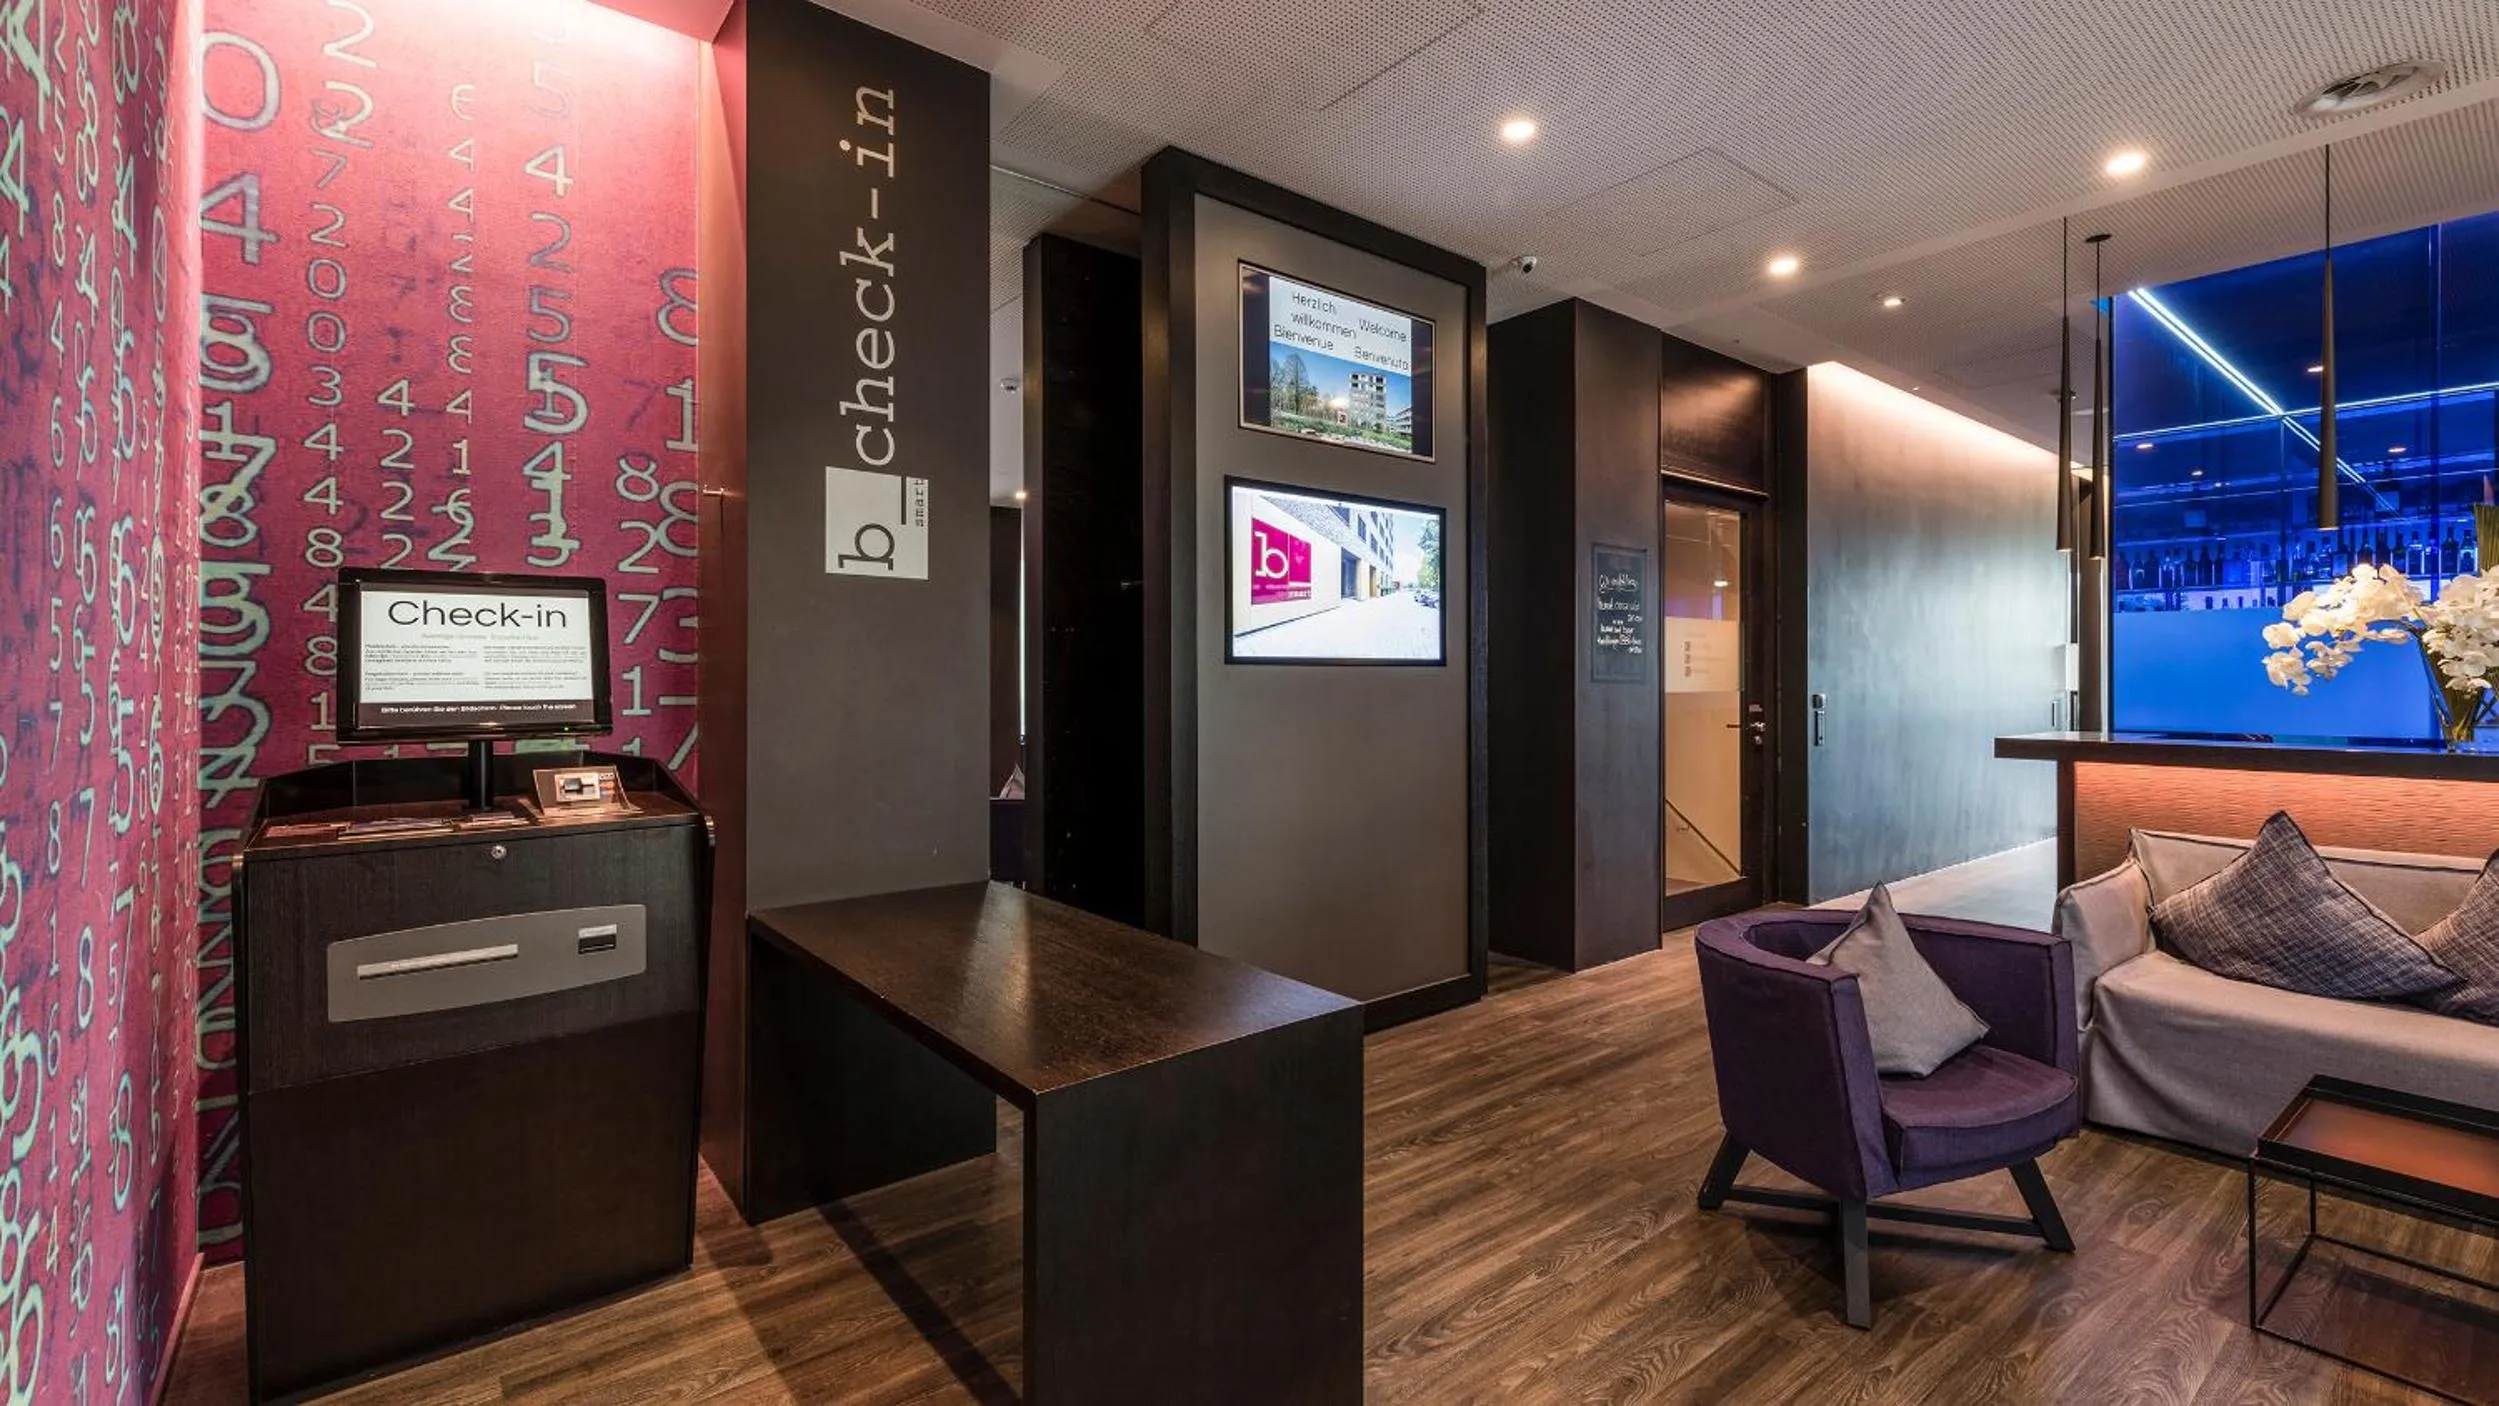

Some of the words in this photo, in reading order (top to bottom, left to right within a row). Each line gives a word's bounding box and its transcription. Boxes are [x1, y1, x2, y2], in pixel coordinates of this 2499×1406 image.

[521, 145, 575, 198] 4
[198, 171, 280, 265] 4
[309, 202, 349, 249] 2
[528, 211, 574, 274] 2
[307, 258, 348, 299] 0
[839, 87, 896, 467] check-in
[526, 285, 573, 343] 5
[1292, 291, 1336, 313] Herzlich
[307, 312, 347, 353] 0
[1273, 323, 1334, 351] Bienvenue
[1290, 312, 1357, 339] willkommen
[1358, 318, 1407, 342] Welcome
[1353, 345, 1409, 371] Benvenuto
[307, 365, 344, 407] 3
[376, 379, 416, 417] 4
[303, 422, 345, 461] 4
[380, 428, 415, 469] 2
[303, 476, 345, 516] 4
[615, 451, 662, 502] 8
[380, 481, 415, 521] 2
[305, 527, 345, 568] 8
[617, 520, 660, 573] 2
[838, 522, 896, 571] b
[388, 599, 568, 628] Check-in
[617, 593, 662, 644] 7
[621, 665, 652, 716] 1
